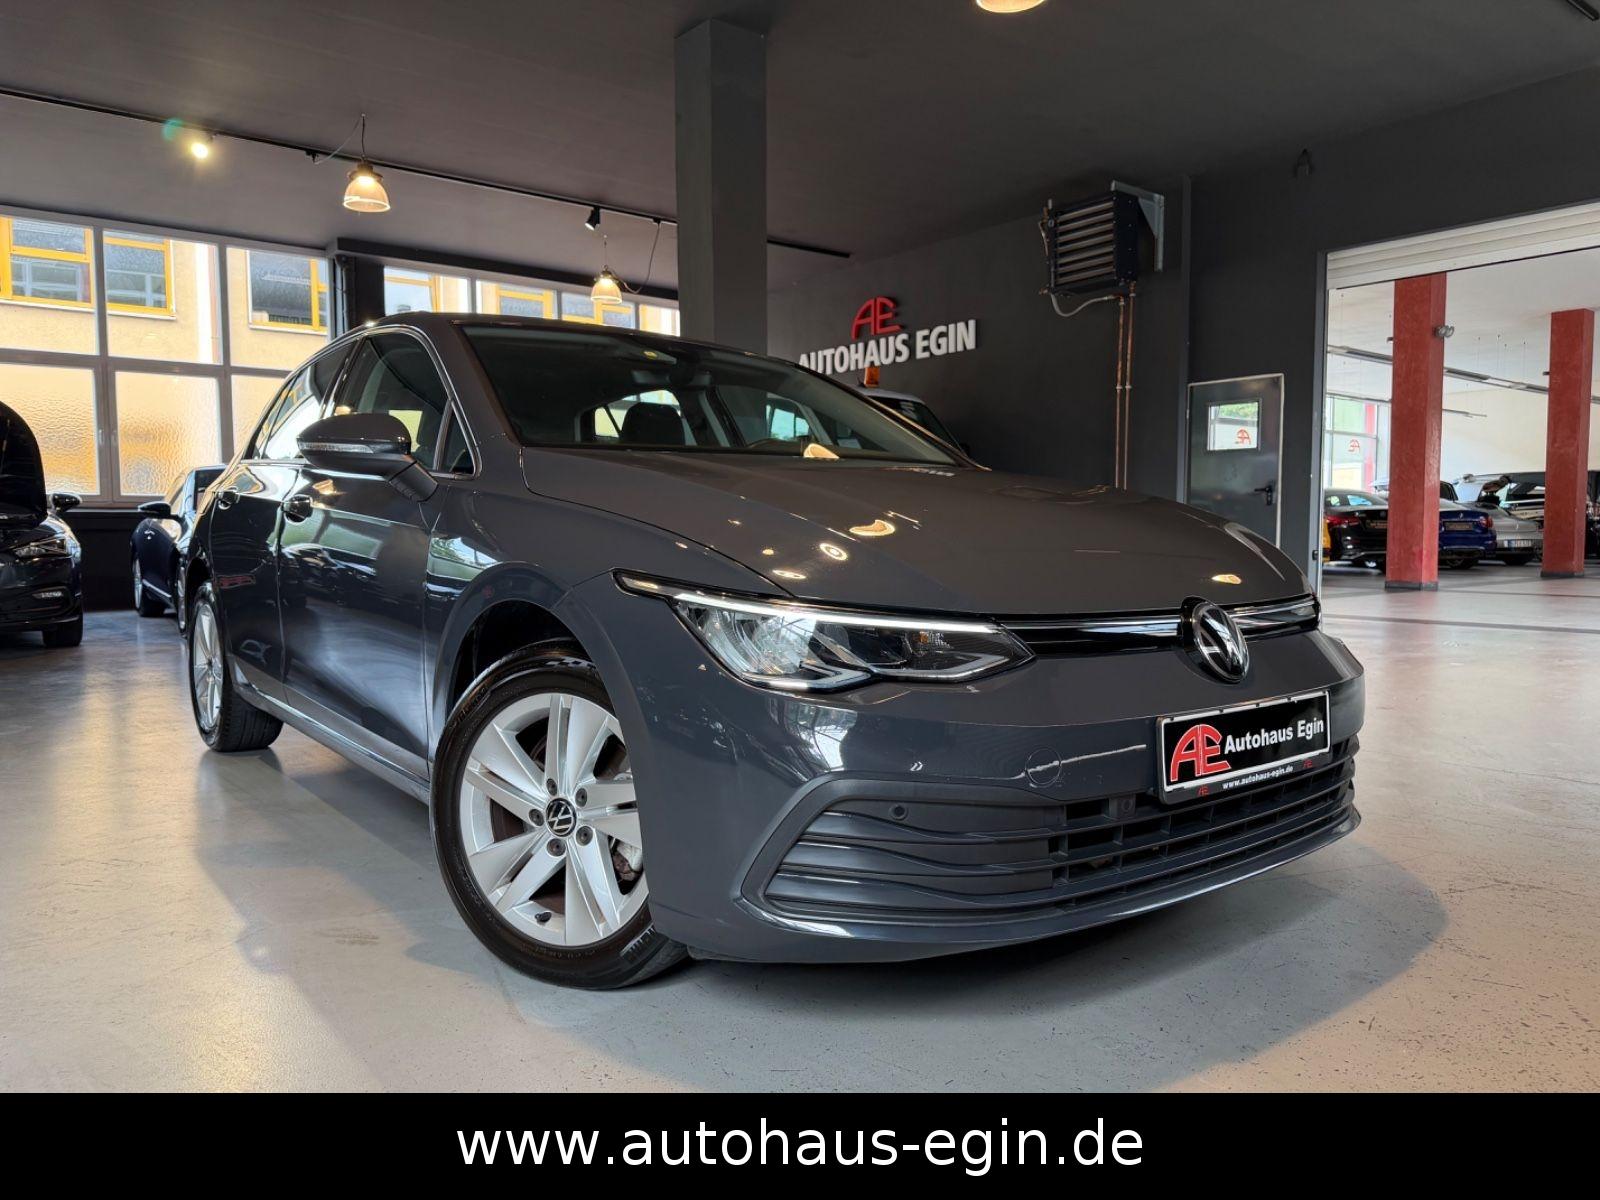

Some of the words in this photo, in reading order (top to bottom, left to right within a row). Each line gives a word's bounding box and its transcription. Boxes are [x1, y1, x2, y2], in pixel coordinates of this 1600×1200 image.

[798, 333, 910, 375] AUTOHAUS
[915, 319, 977, 360] EGIN
[1224, 726, 1294, 755] Autohaus
[1297, 718, 1324, 739] Egin
[1222, 765, 1293, 789] www.autohaus-egin.de
